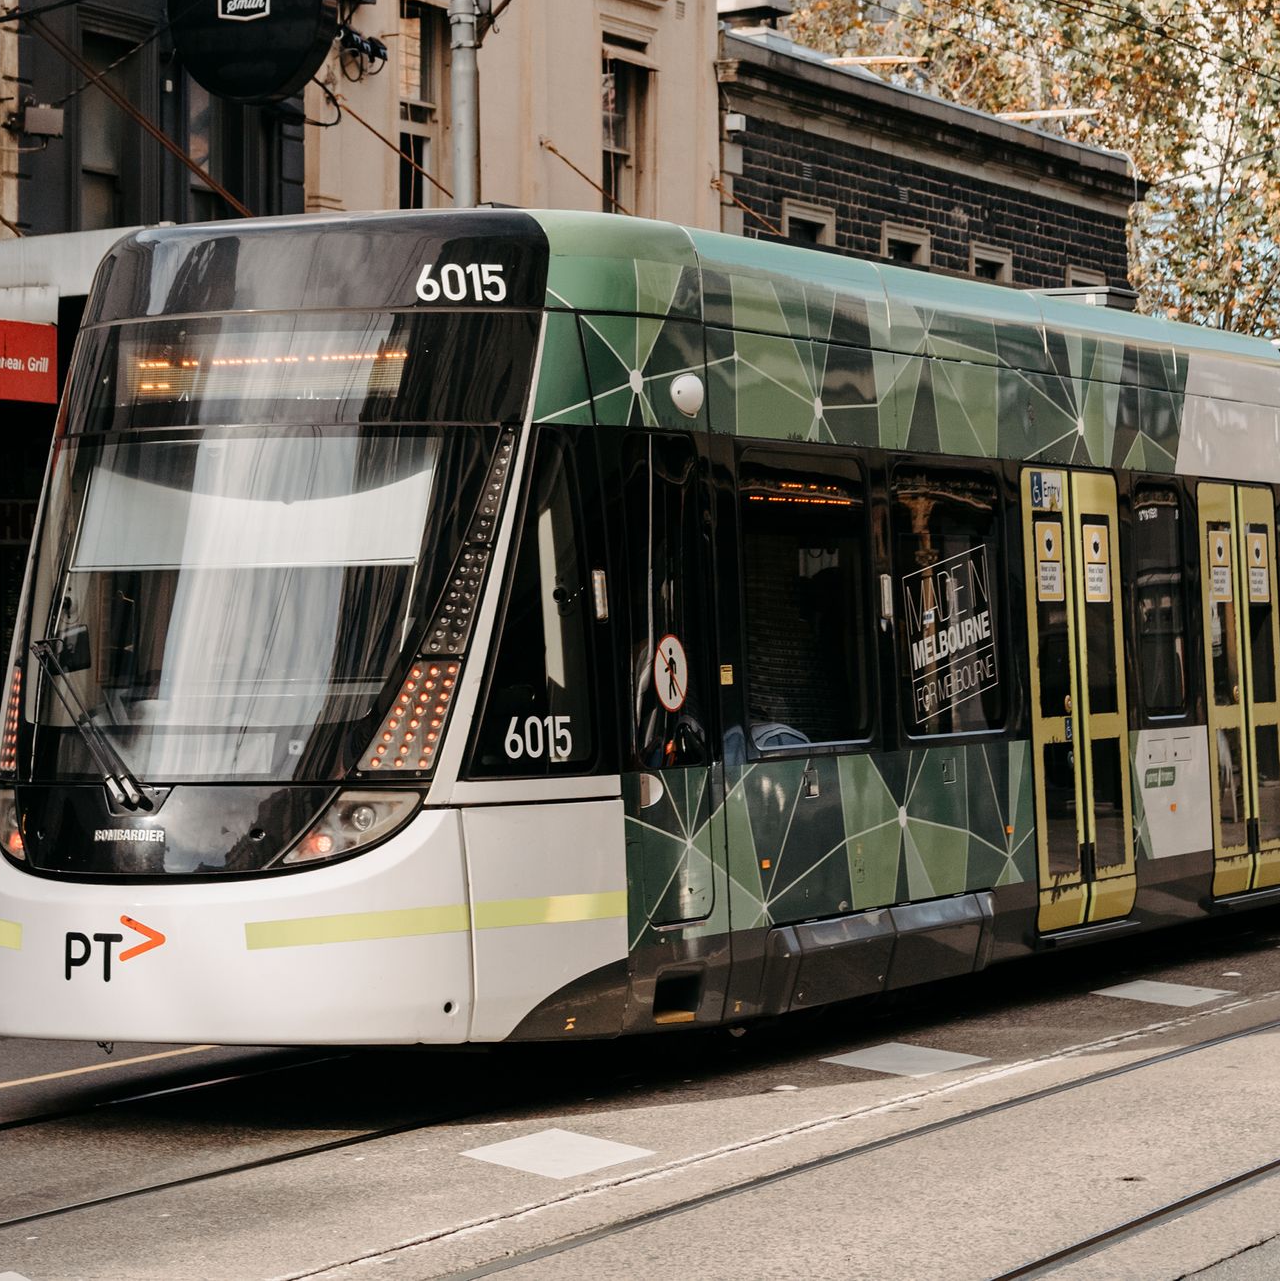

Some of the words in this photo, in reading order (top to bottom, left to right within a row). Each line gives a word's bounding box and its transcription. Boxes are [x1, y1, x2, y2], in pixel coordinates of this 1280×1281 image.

[416, 263, 507, 302] 6015
[27, 356, 49, 373] Grill
[1044, 482, 1061, 502] Entry
[912, 610, 991, 671] MELBOURNE
[916, 681, 938, 712] FOR
[938, 654, 996, 702] MELBOURNE
[505, 715, 573, 760] 6015
[94, 829, 165, 842] BOMBARDIER
